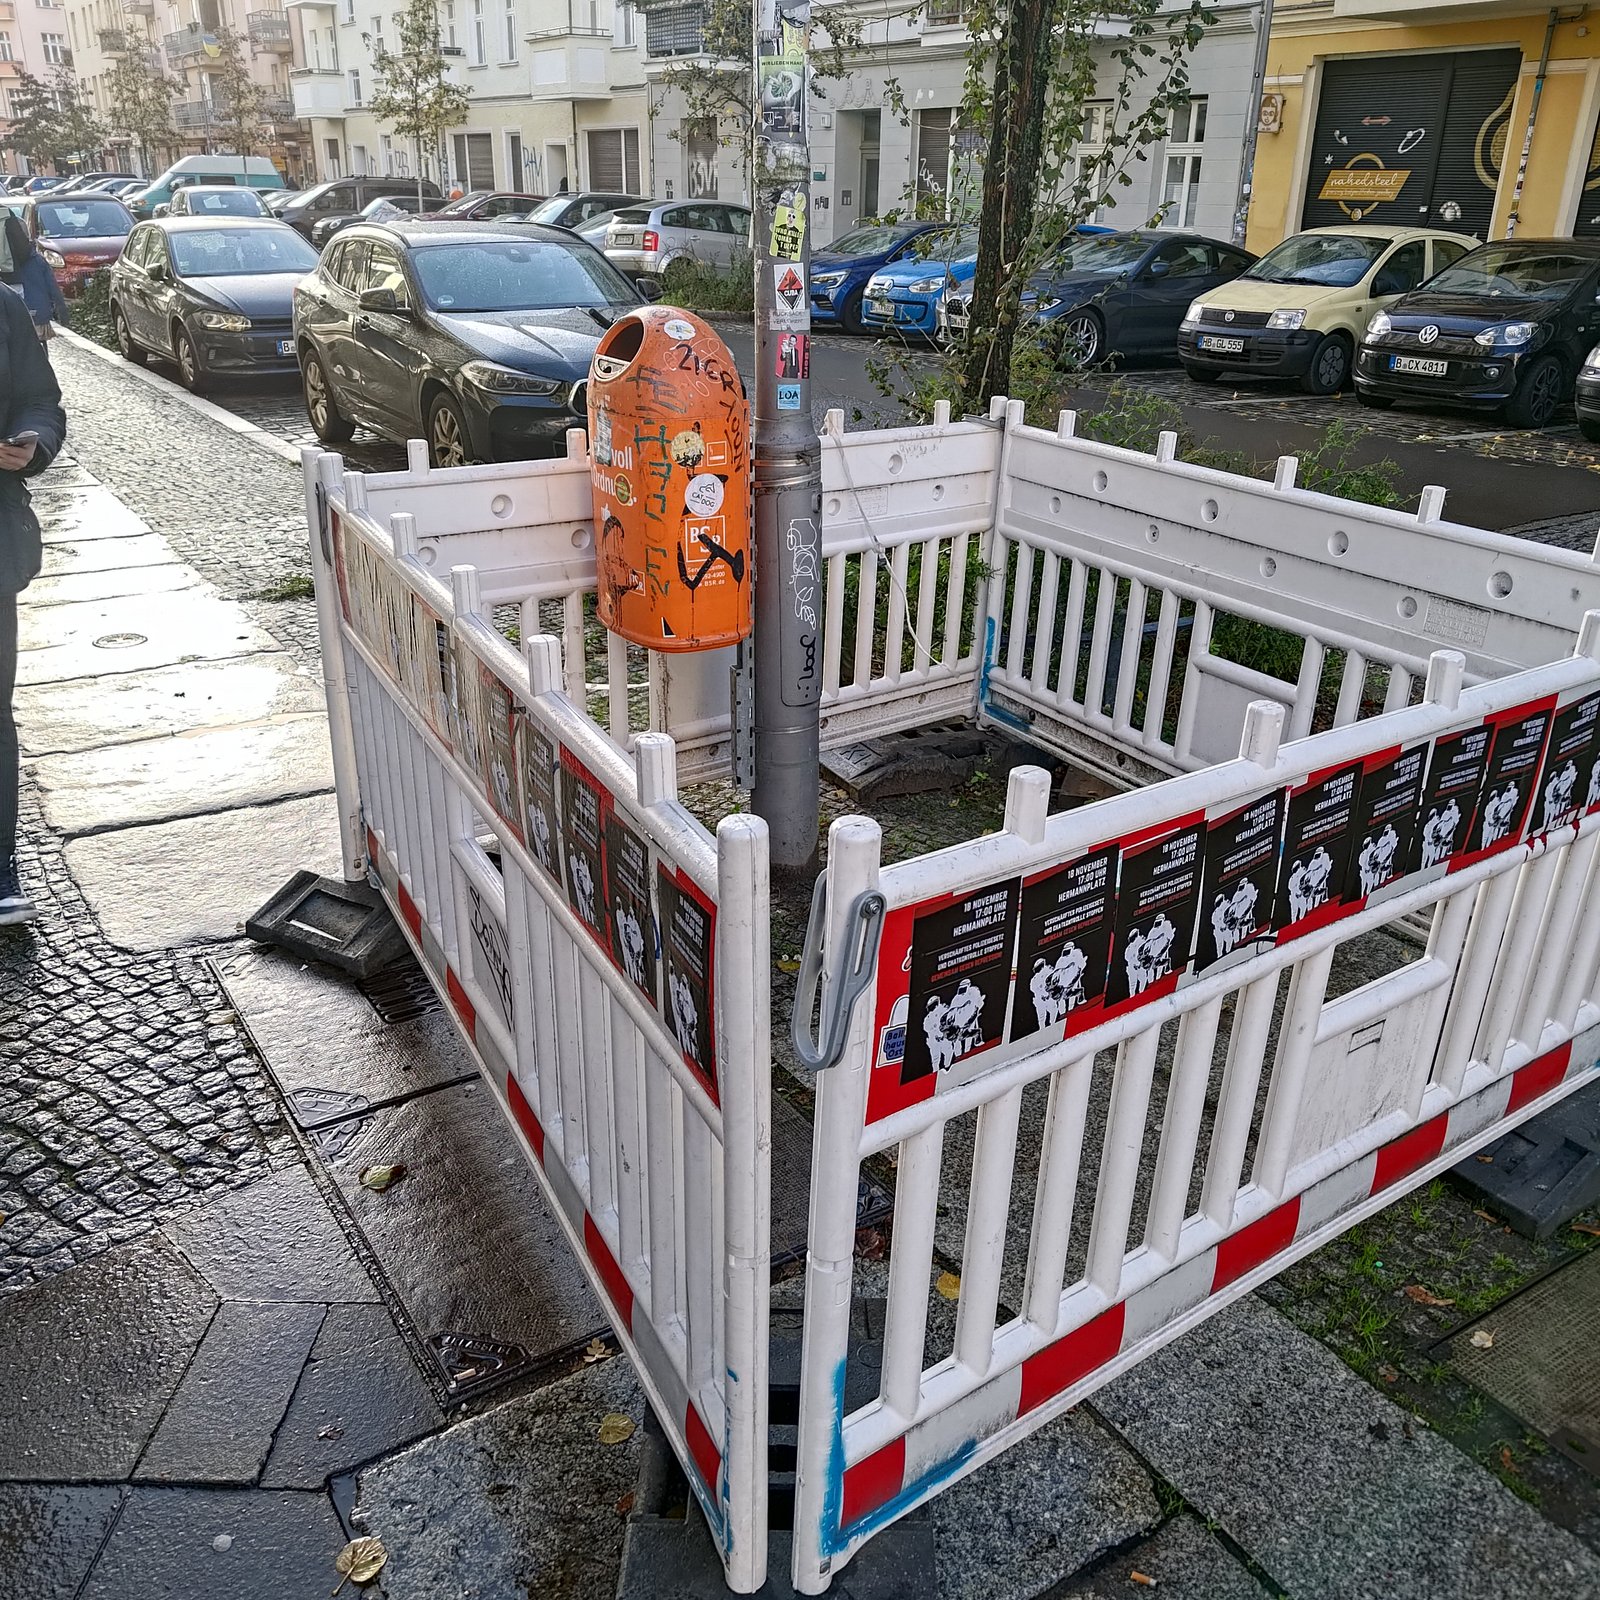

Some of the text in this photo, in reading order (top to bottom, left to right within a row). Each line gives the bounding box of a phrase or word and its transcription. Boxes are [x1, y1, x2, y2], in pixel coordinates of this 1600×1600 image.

[1331, 172, 1398, 186] nakedsteel
[283, 342, 289, 352] B
[1204, 338, 1242, 350] HB GL 555
[1396, 358, 1444, 373] B CX 4811
[779, 390, 798, 399] LOA
[612, 446, 632, 470] voll
[692, 492, 704, 500] CAT
[701, 498, 715, 508] DOG
[1162, 833, 1198, 853] 18 NOVEMBER
[1186, 843, 1196, 852] UHR
[1068, 857, 1108, 878] 18 NOVEMBER
[1153, 852, 1195, 875] HERMANNPLATZ
[1096, 867, 1106, 878] UHR
[1058, 877, 1106, 902] HERMANNPLATZ
[964, 890, 1008, 912] 18 NOVEMBER
[994, 901, 1006, 912] UHR
[953, 912, 1006, 937] HERMANNPLATZ
[888, 1048, 903, 1057] Ost
